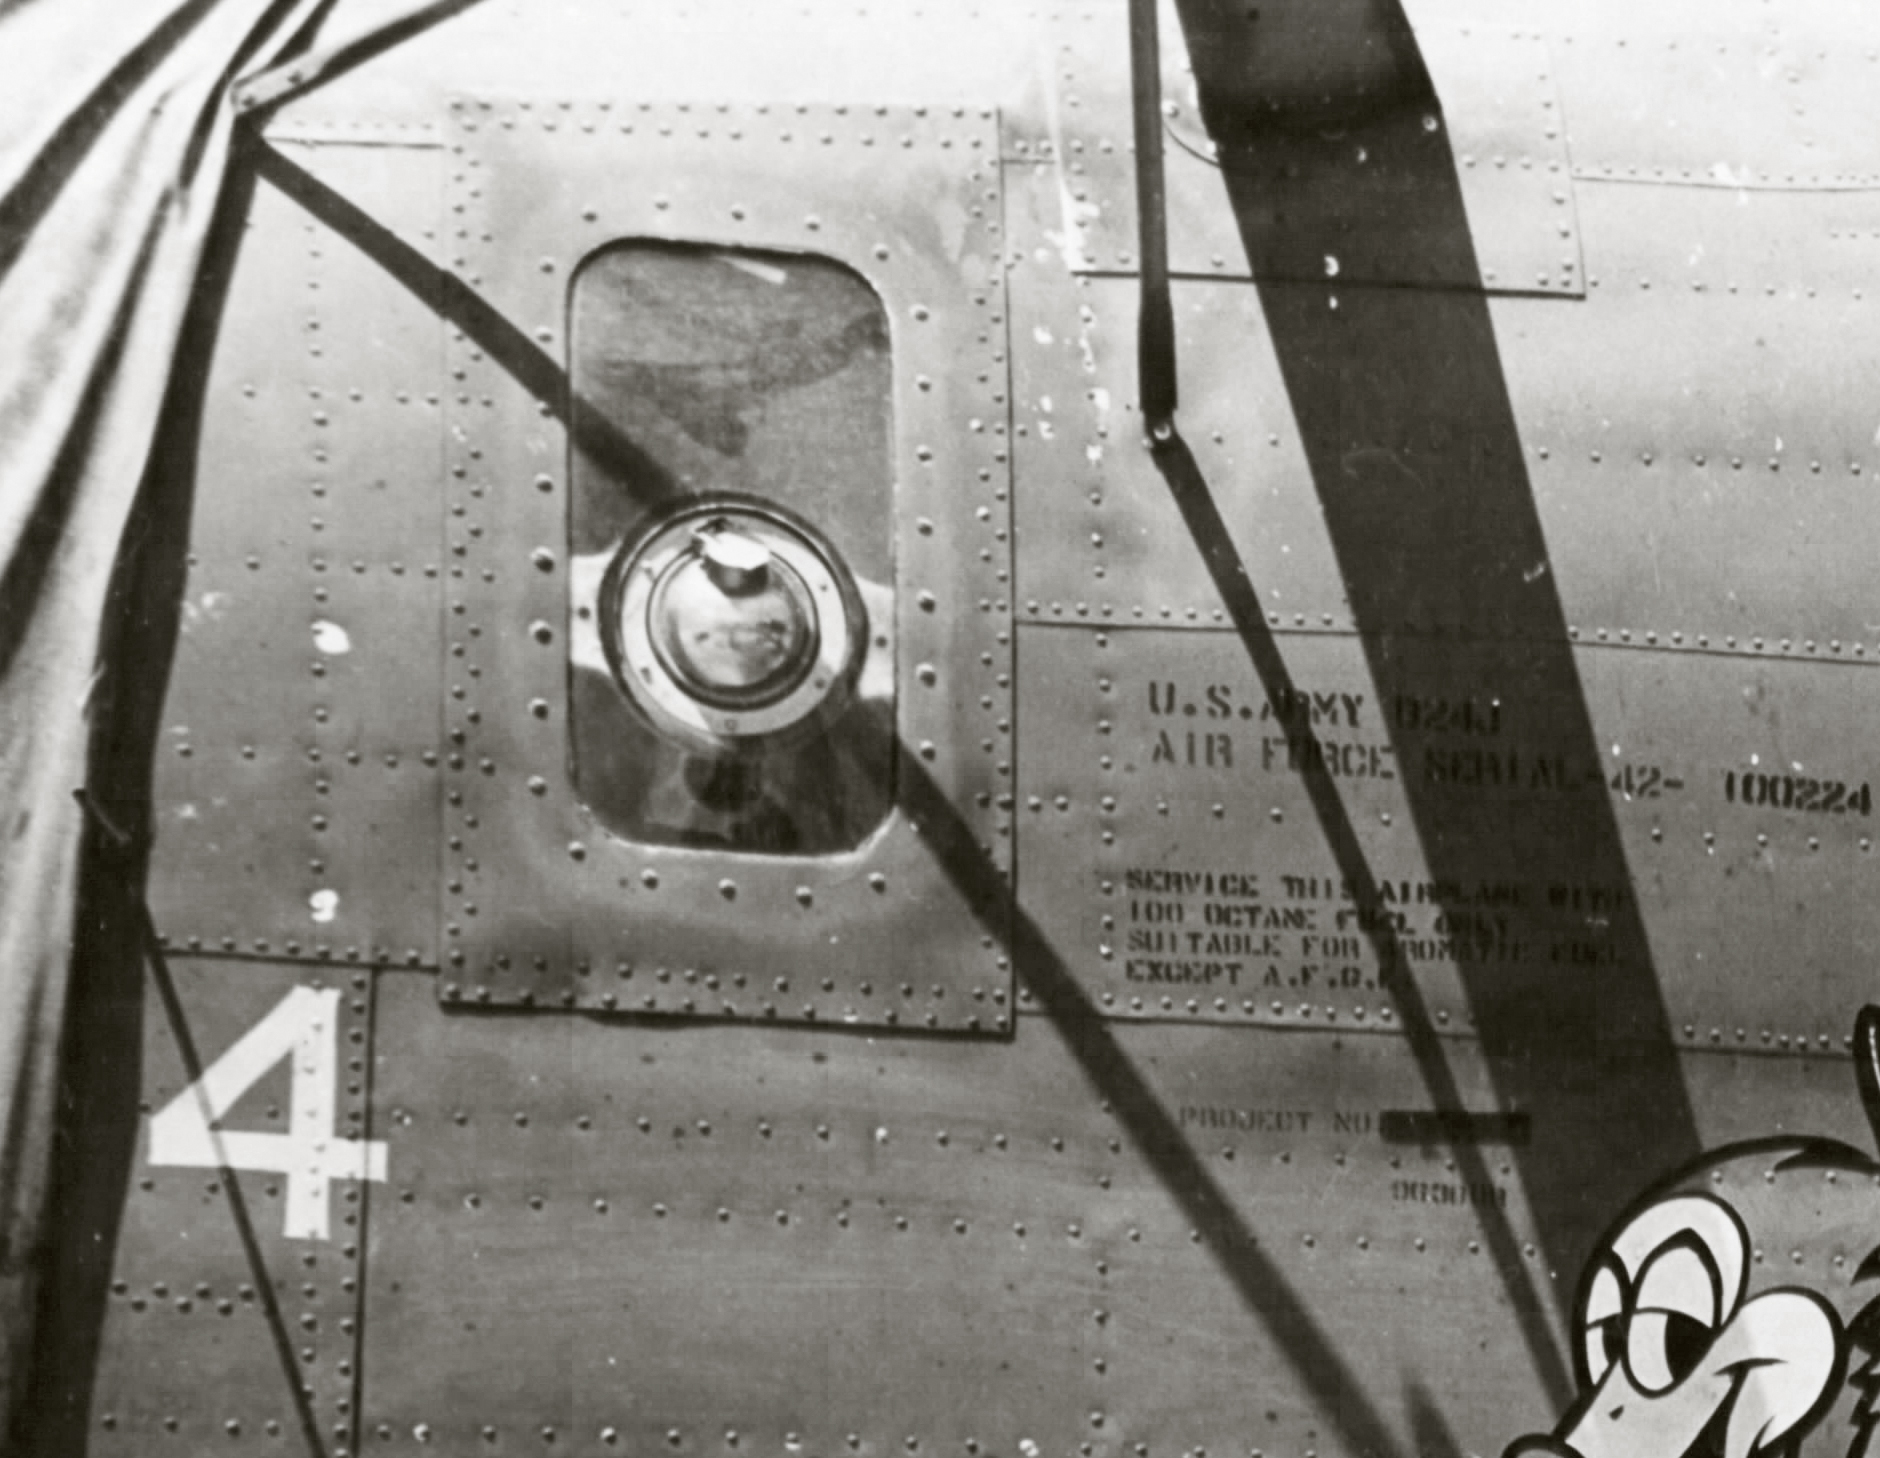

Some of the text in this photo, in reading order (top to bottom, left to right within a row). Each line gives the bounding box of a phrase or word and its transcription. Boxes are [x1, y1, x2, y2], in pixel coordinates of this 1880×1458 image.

[1151, 729, 1234, 769] AIR
[1261, 736, 1397, 780] FORCE
[1724, 770, 1872, 817] 100224
[1125, 868, 1260, 898] SERVICE
[1280, 875, 1358, 902] THIS
[1380, 880, 1529, 906] AIRPLANE
[1129, 899, 1185, 924] 100
[1204, 902, 1318, 931] OCTANE
[1335, 909, 1417, 936] FUEL
[1127, 928, 1283, 958] SUITABLE
[1301, 935, 1361, 959] FOR
[1125, 958, 1243, 987] EXCEPT
[148, 984, 389, 1240] 4
[1178, 1106, 1313, 1134] PROJECT
